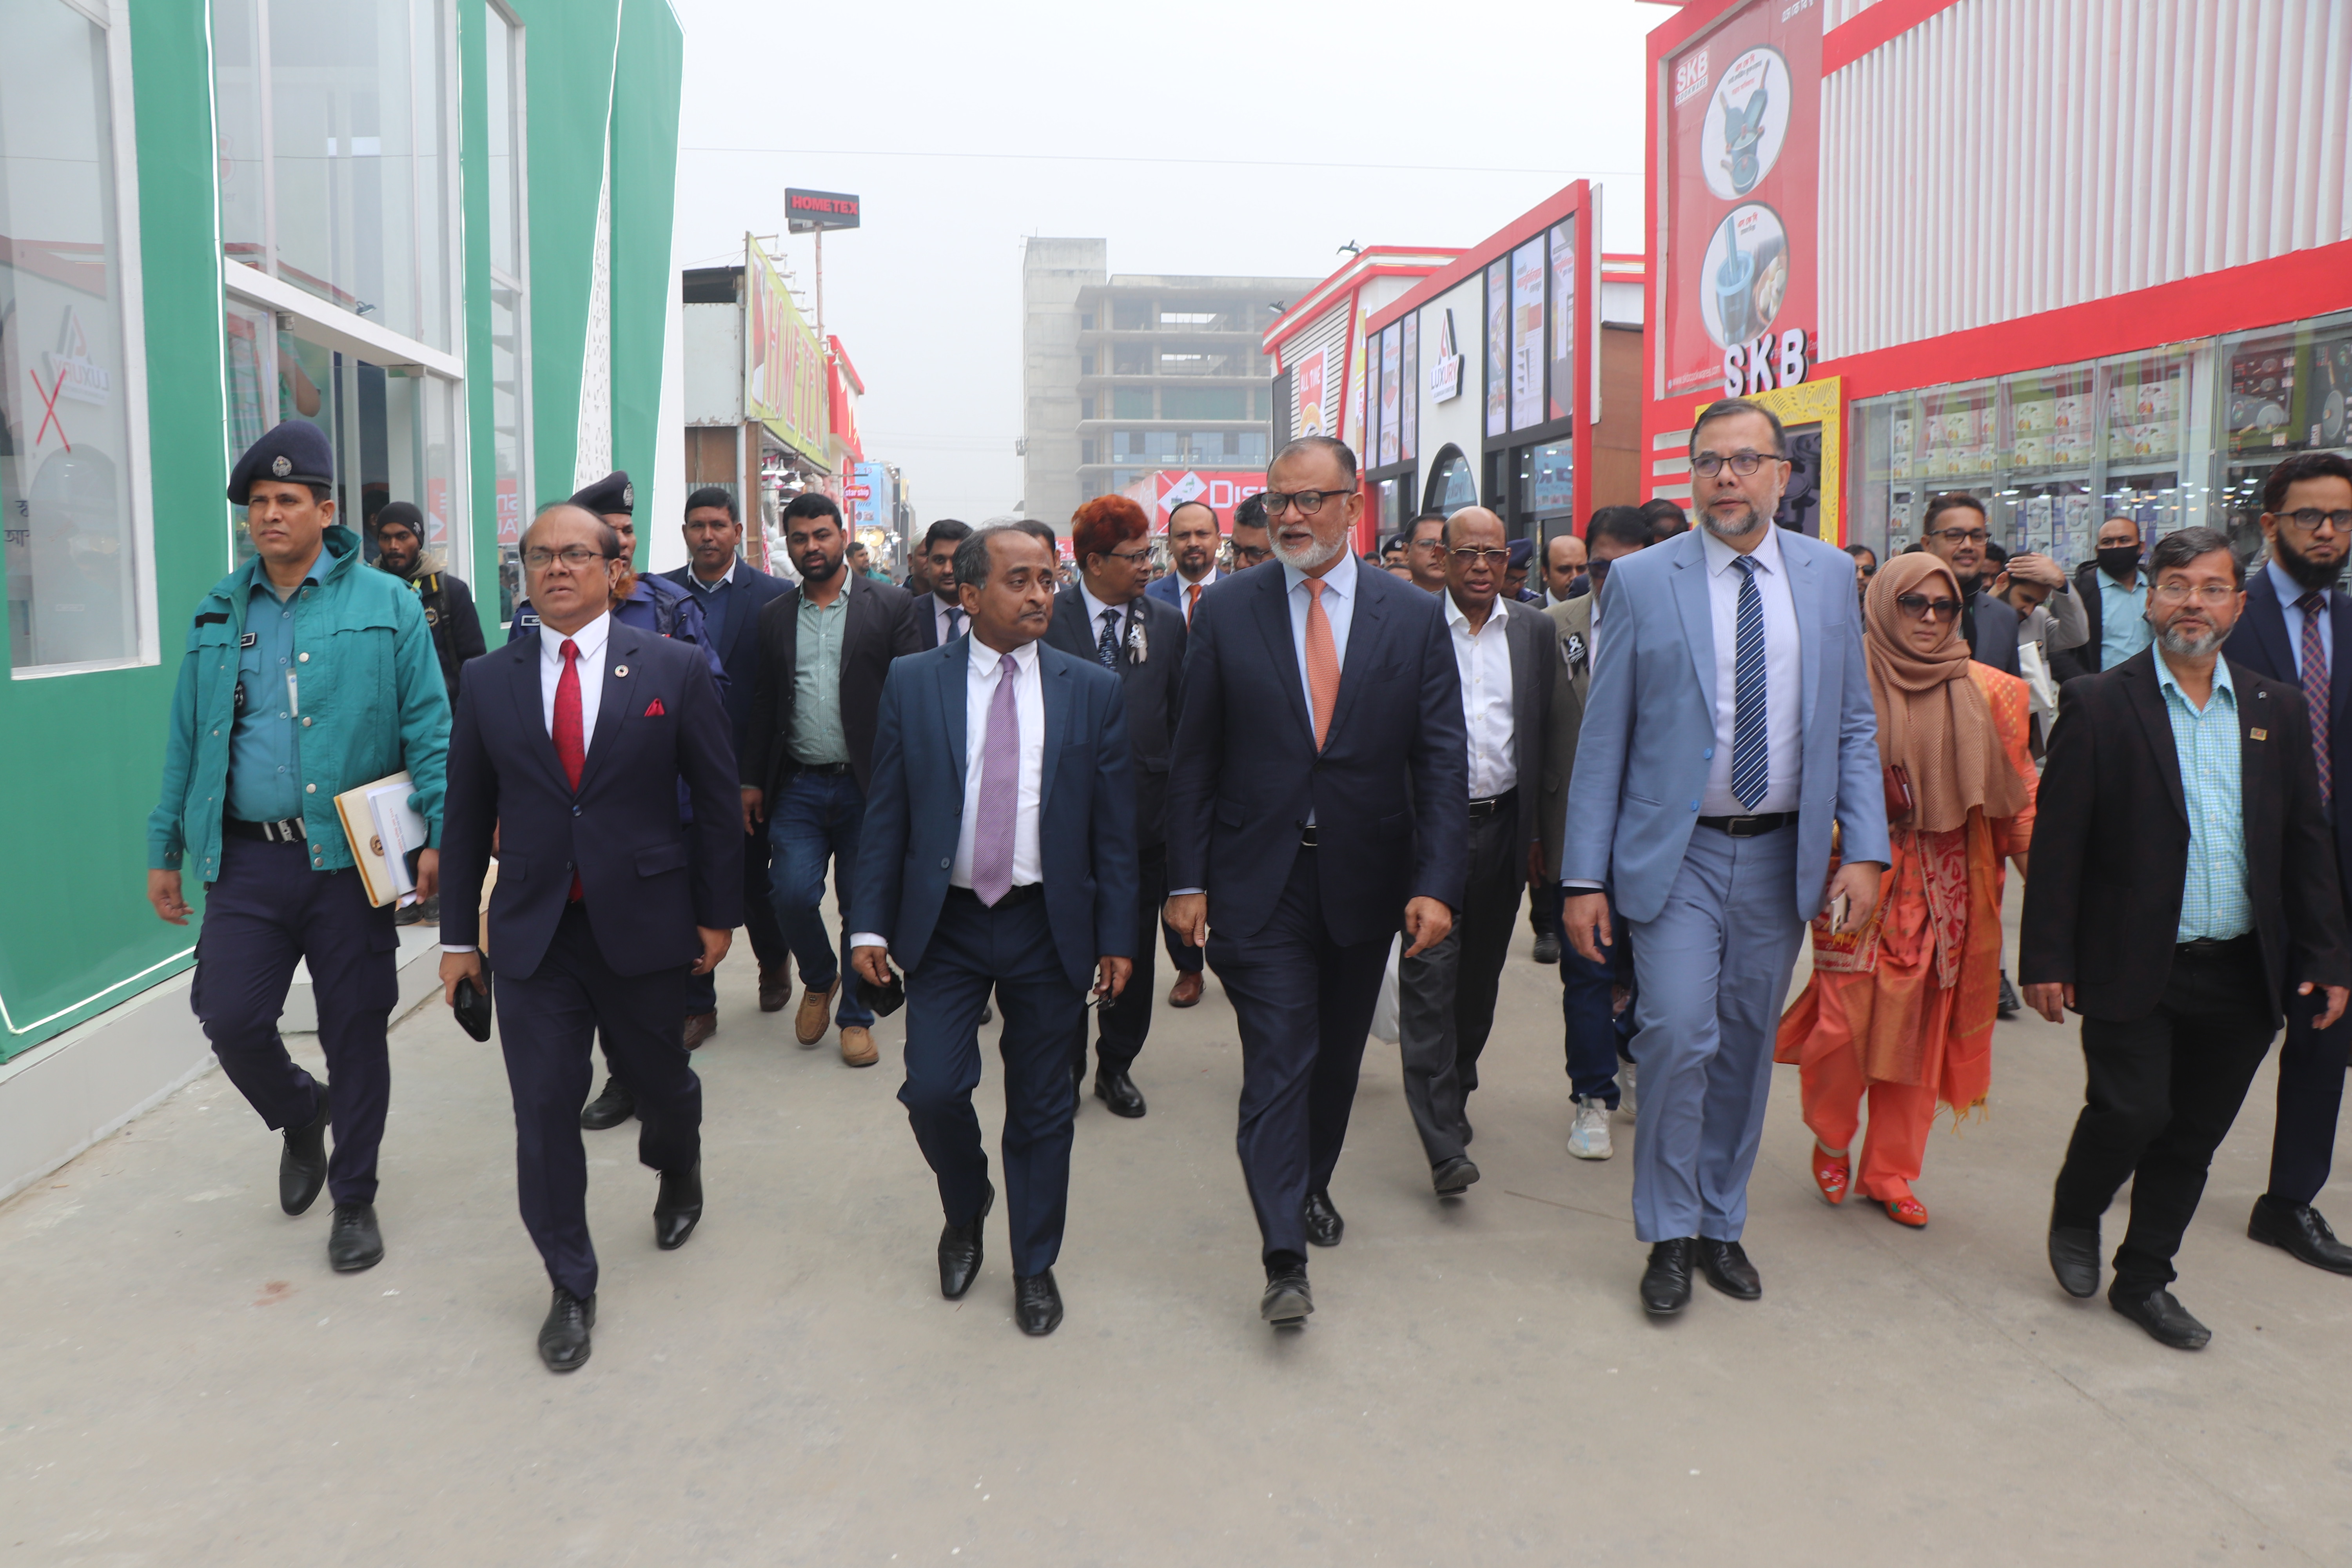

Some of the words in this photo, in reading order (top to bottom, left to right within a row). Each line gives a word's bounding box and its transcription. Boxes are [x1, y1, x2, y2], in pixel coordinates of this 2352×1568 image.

[1677, 51, 1708, 93] SKB
[1677, 76, 1707, 103] COOKWARE
[1431, 359, 1457, 390] LUXURY
[1724, 328, 1806, 398] SKB
[845, 488, 856, 497] star
[1210, 480, 1267, 509] DIS
